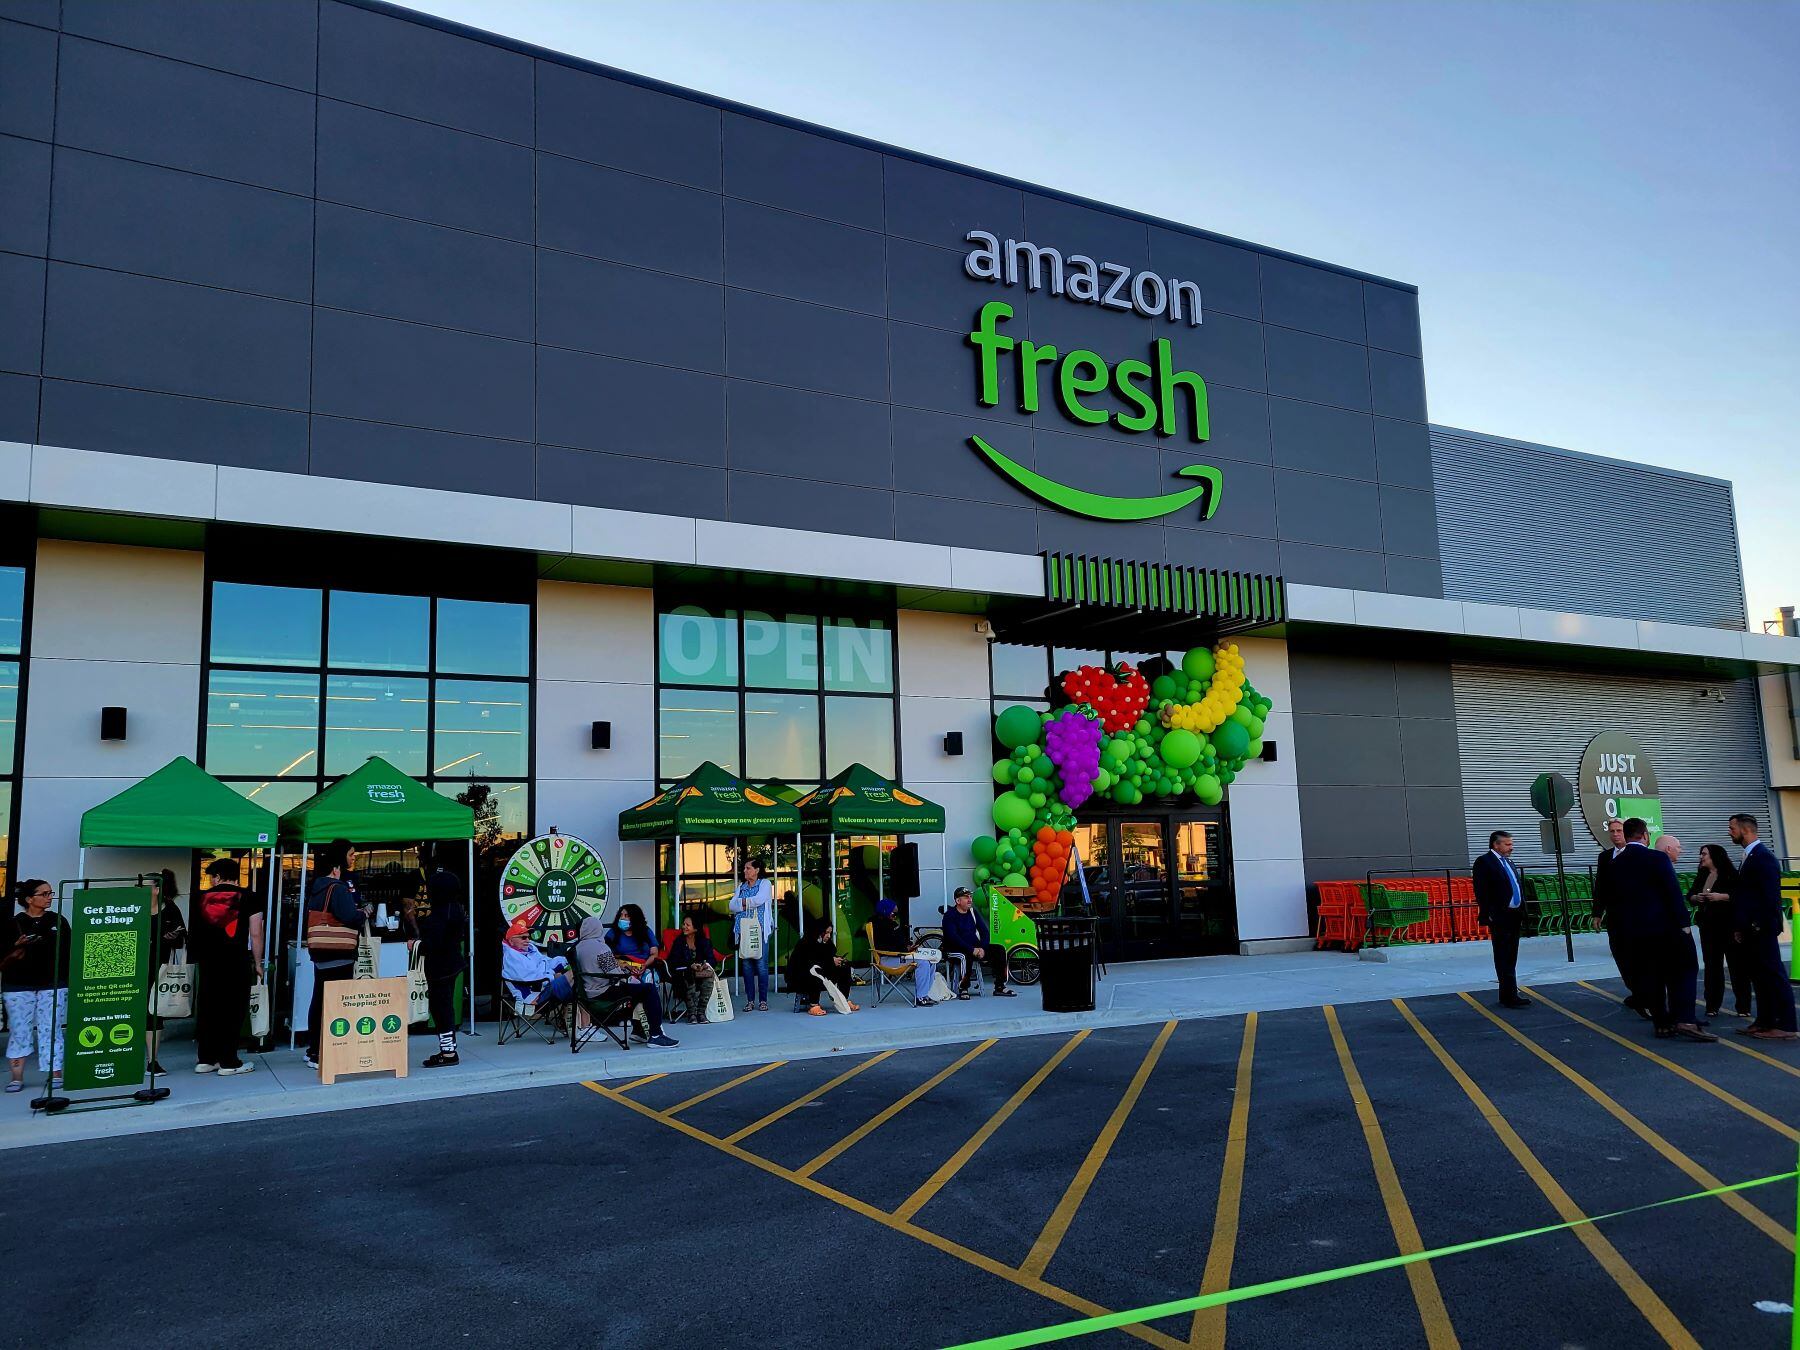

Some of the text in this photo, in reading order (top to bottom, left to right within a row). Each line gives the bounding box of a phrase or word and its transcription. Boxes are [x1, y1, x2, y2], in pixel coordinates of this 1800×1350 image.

[965, 231, 1203, 326] amazon
[968, 301, 1210, 441] fresh
[664, 605, 886, 684] OPEN
[1598, 753, 1636, 773] JUST
[1595, 775, 1644, 795] WALK
[367, 789, 405, 798] fresh
[713, 791, 742, 799] fresh
[752, 817, 776, 825] grocery
[900, 817, 923, 825] grocery
[547, 879, 567, 888] Spin
[547, 895, 566, 903] Win
[83, 905, 142, 915] Get Ready
[90, 915, 134, 925] to Shop
[109, 988, 140, 996] download
[341, 994, 357, 1002] Just
[342, 1000, 378, 1008] Shopping
[94, 1067, 114, 1075] fresh
